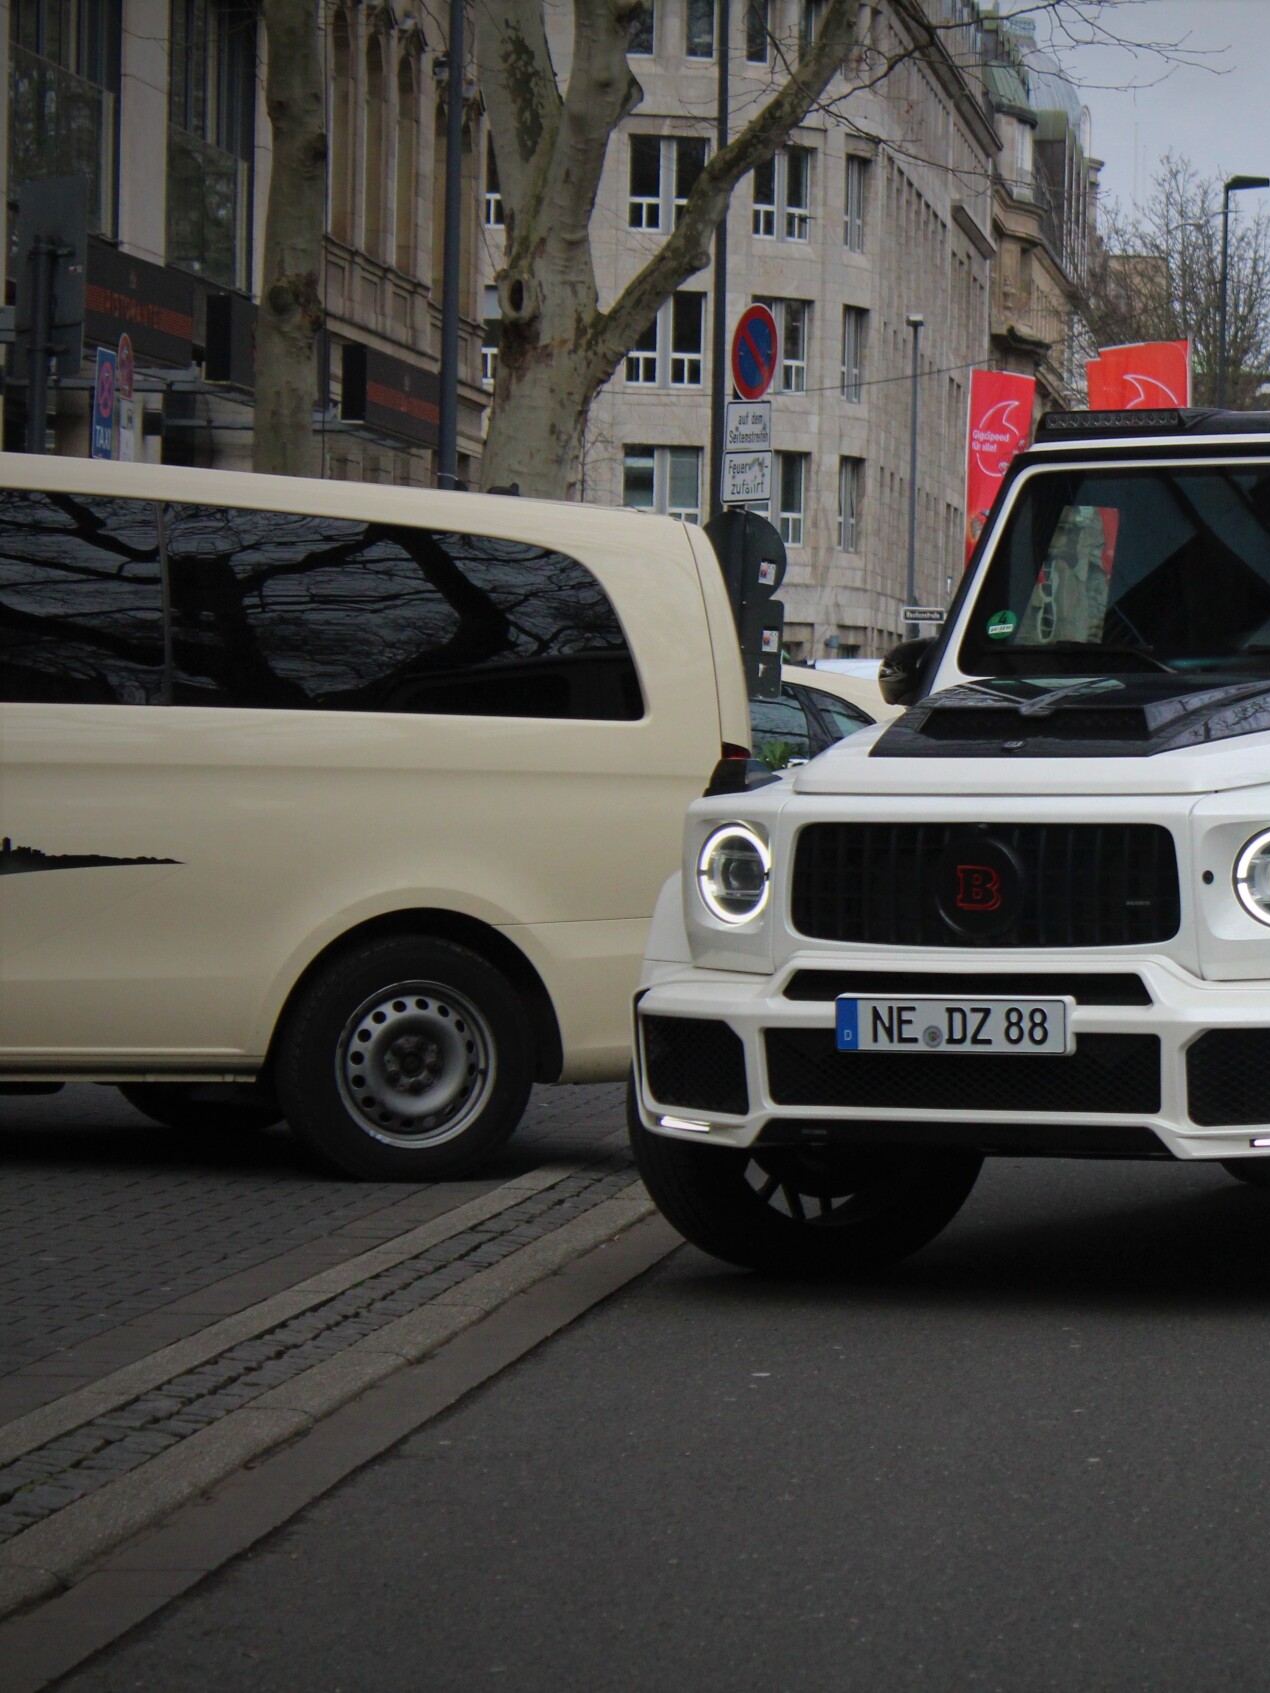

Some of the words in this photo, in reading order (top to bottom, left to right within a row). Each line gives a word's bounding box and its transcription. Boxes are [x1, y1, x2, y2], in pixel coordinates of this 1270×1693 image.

[738, 411, 749, 425] auf
[751, 411, 763, 425] dem
[95, 425, 113, 451] TAXI
[728, 429, 769, 444] Seitenstreifen
[972, 431, 1010, 445] GigaSpeed
[998, 611, 1009, 625] 4
[956, 865, 1001, 911] B
[871, 1005, 919, 1044] NE
[945, 1007, 993, 1046] DZ
[1004, 1007, 1049, 1046] 88
[843, 1029, 852, 1041] D
